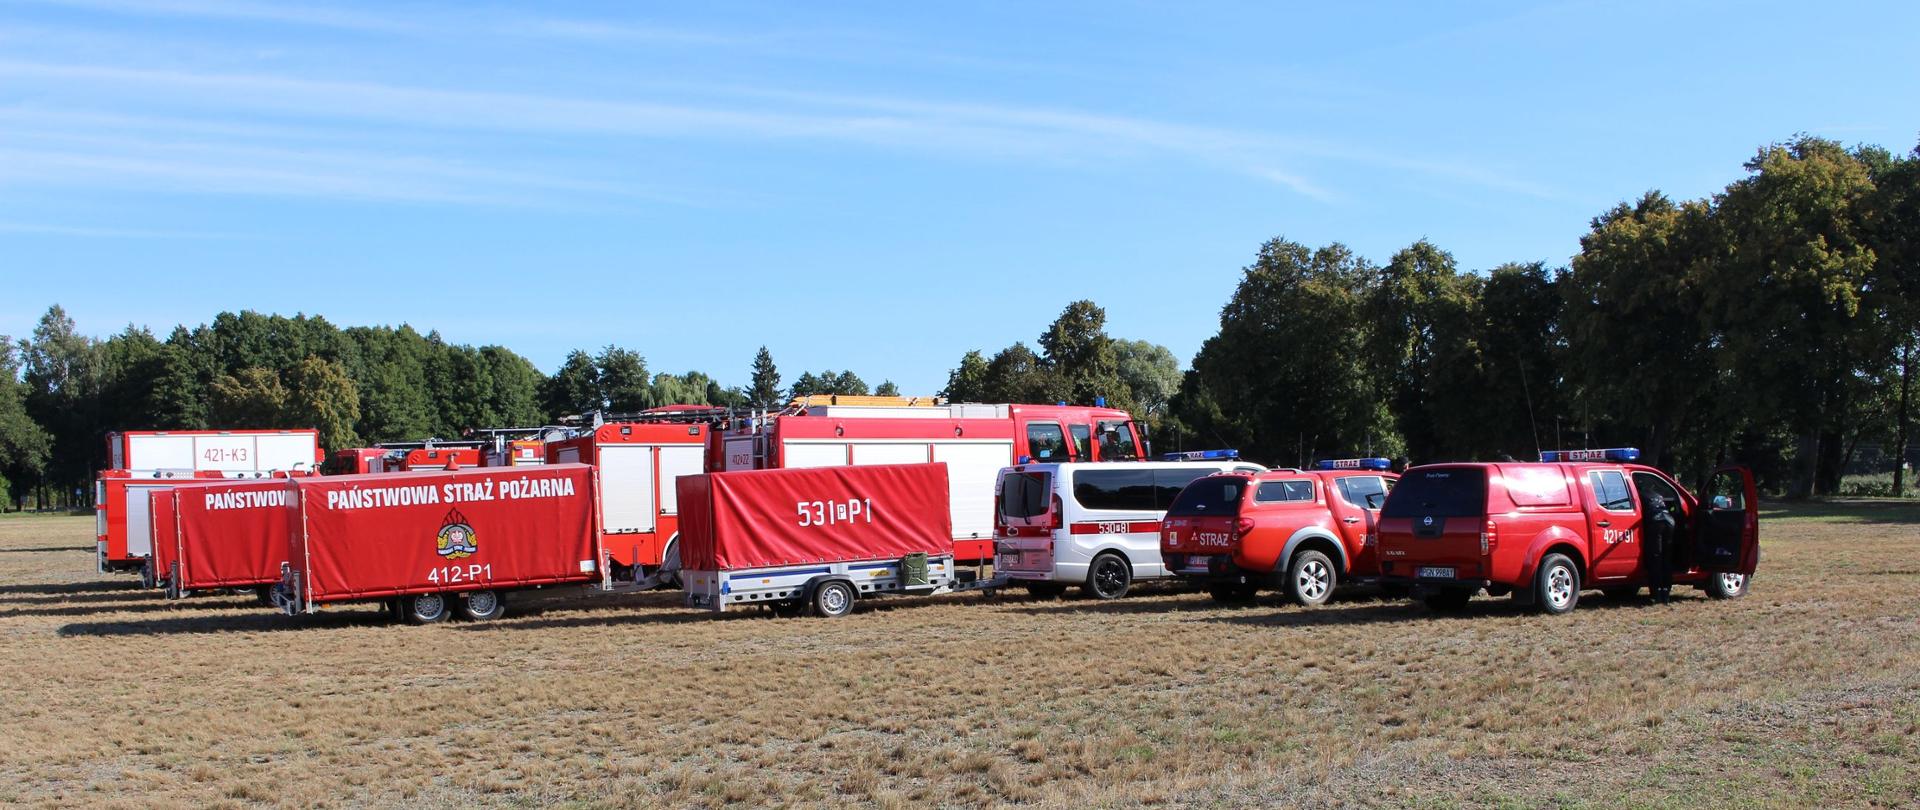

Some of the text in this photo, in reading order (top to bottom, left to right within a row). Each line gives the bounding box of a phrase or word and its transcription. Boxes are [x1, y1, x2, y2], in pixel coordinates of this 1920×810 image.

[204, 448, 247, 462] 421-K3
[327, 476, 575, 510] PAŃSTWOWA STRAŻ POŻARNA
[427, 563, 492, 584] 412-P1
